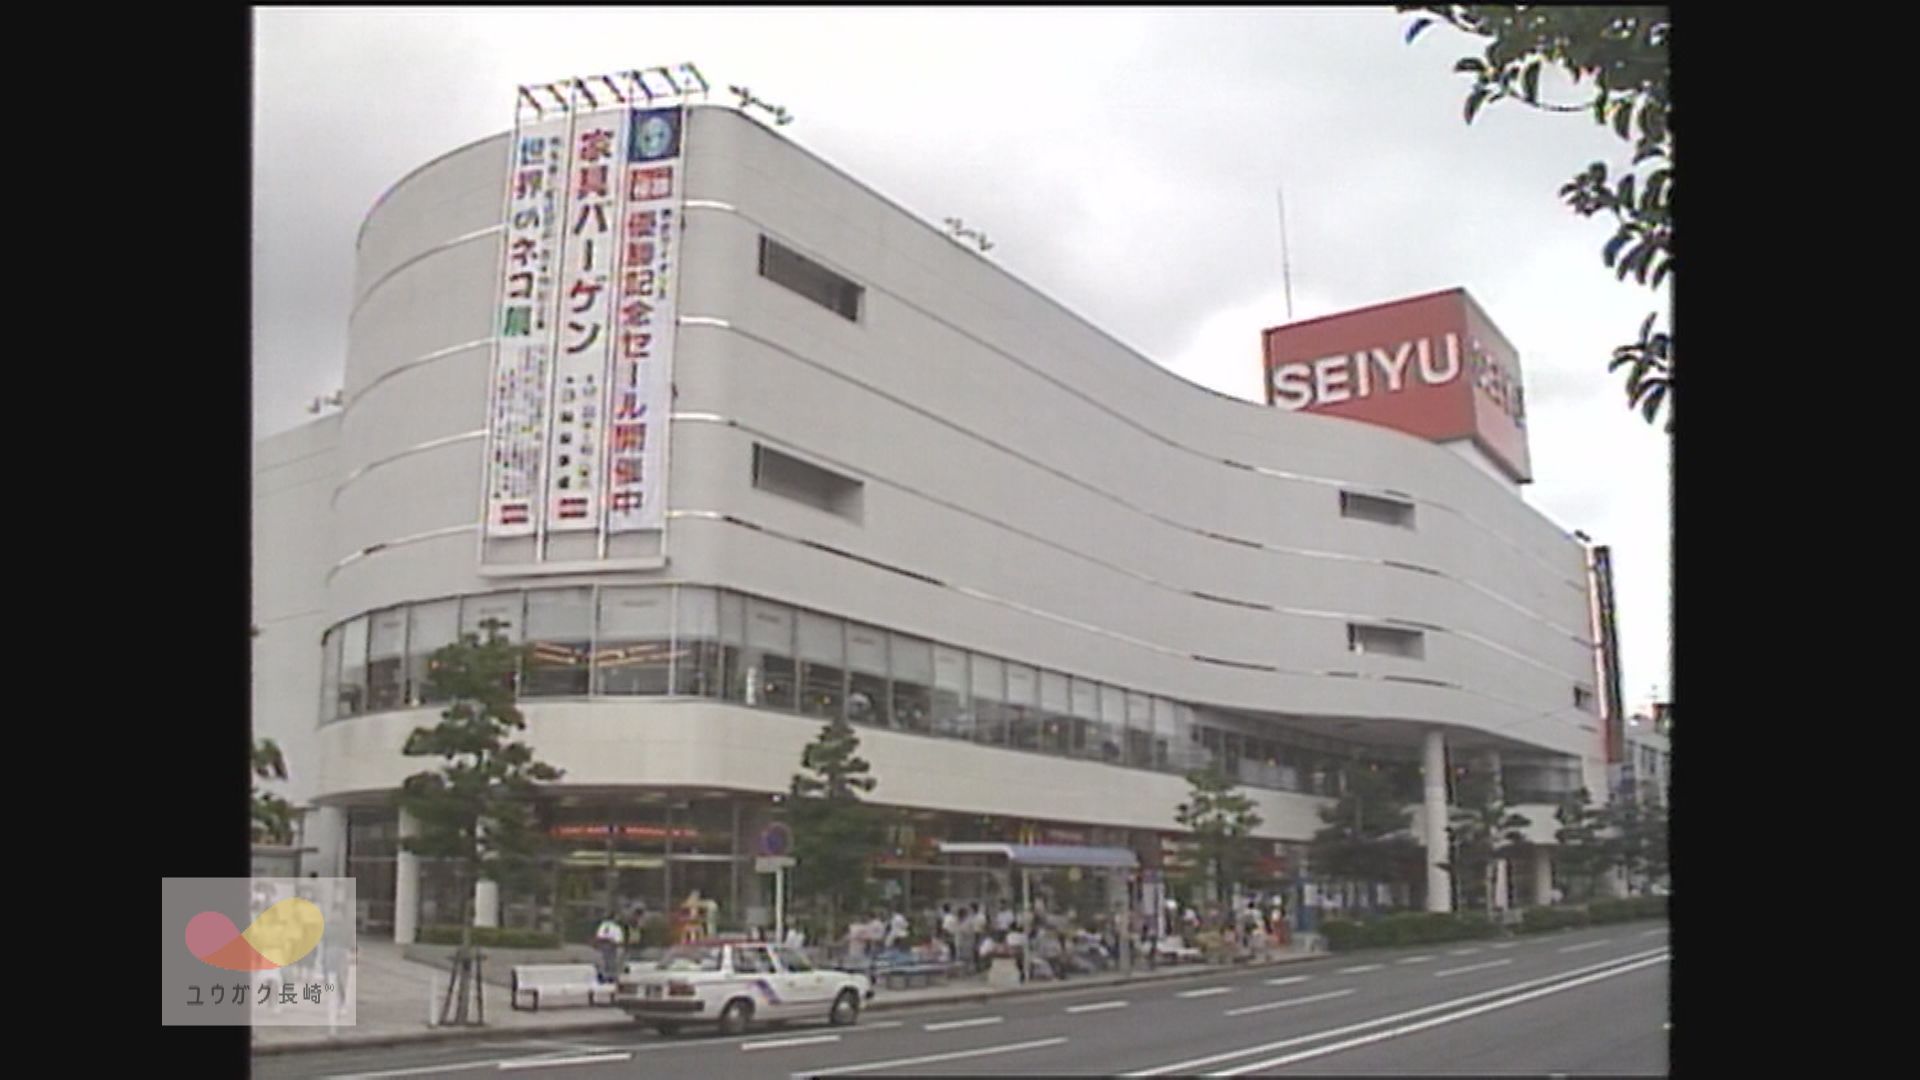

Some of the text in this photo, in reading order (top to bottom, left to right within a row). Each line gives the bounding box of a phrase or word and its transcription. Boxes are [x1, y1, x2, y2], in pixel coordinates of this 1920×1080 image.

[566, 128, 615, 354] 家具バーゲン
[1273, 333, 1460, 411] SEIYU
